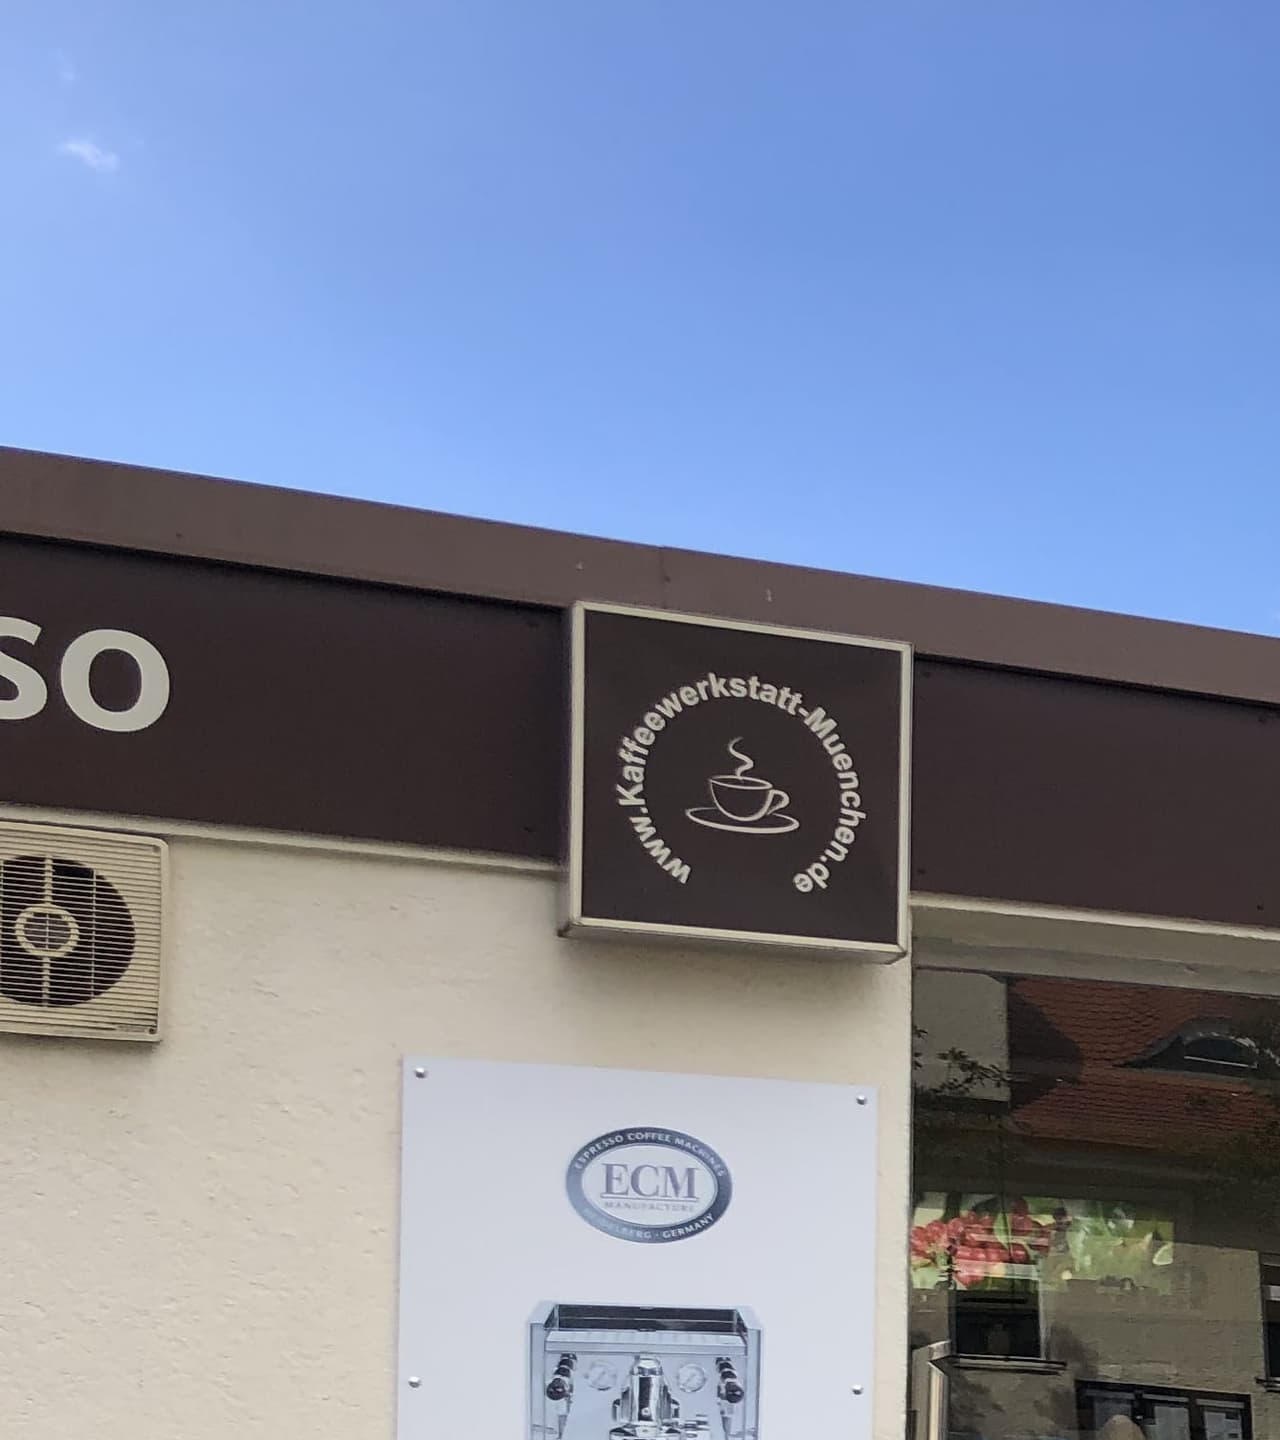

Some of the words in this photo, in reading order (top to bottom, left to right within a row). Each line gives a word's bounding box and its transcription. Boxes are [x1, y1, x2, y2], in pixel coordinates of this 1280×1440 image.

[616, 672, 866, 895] www.Kaffeewerkstatt-Muenchen.de
[627, 1131, 671, 1143] COFFEE
[601, 1163, 699, 1199] ECM
[662, 1212, 715, 1239] GERMANY
